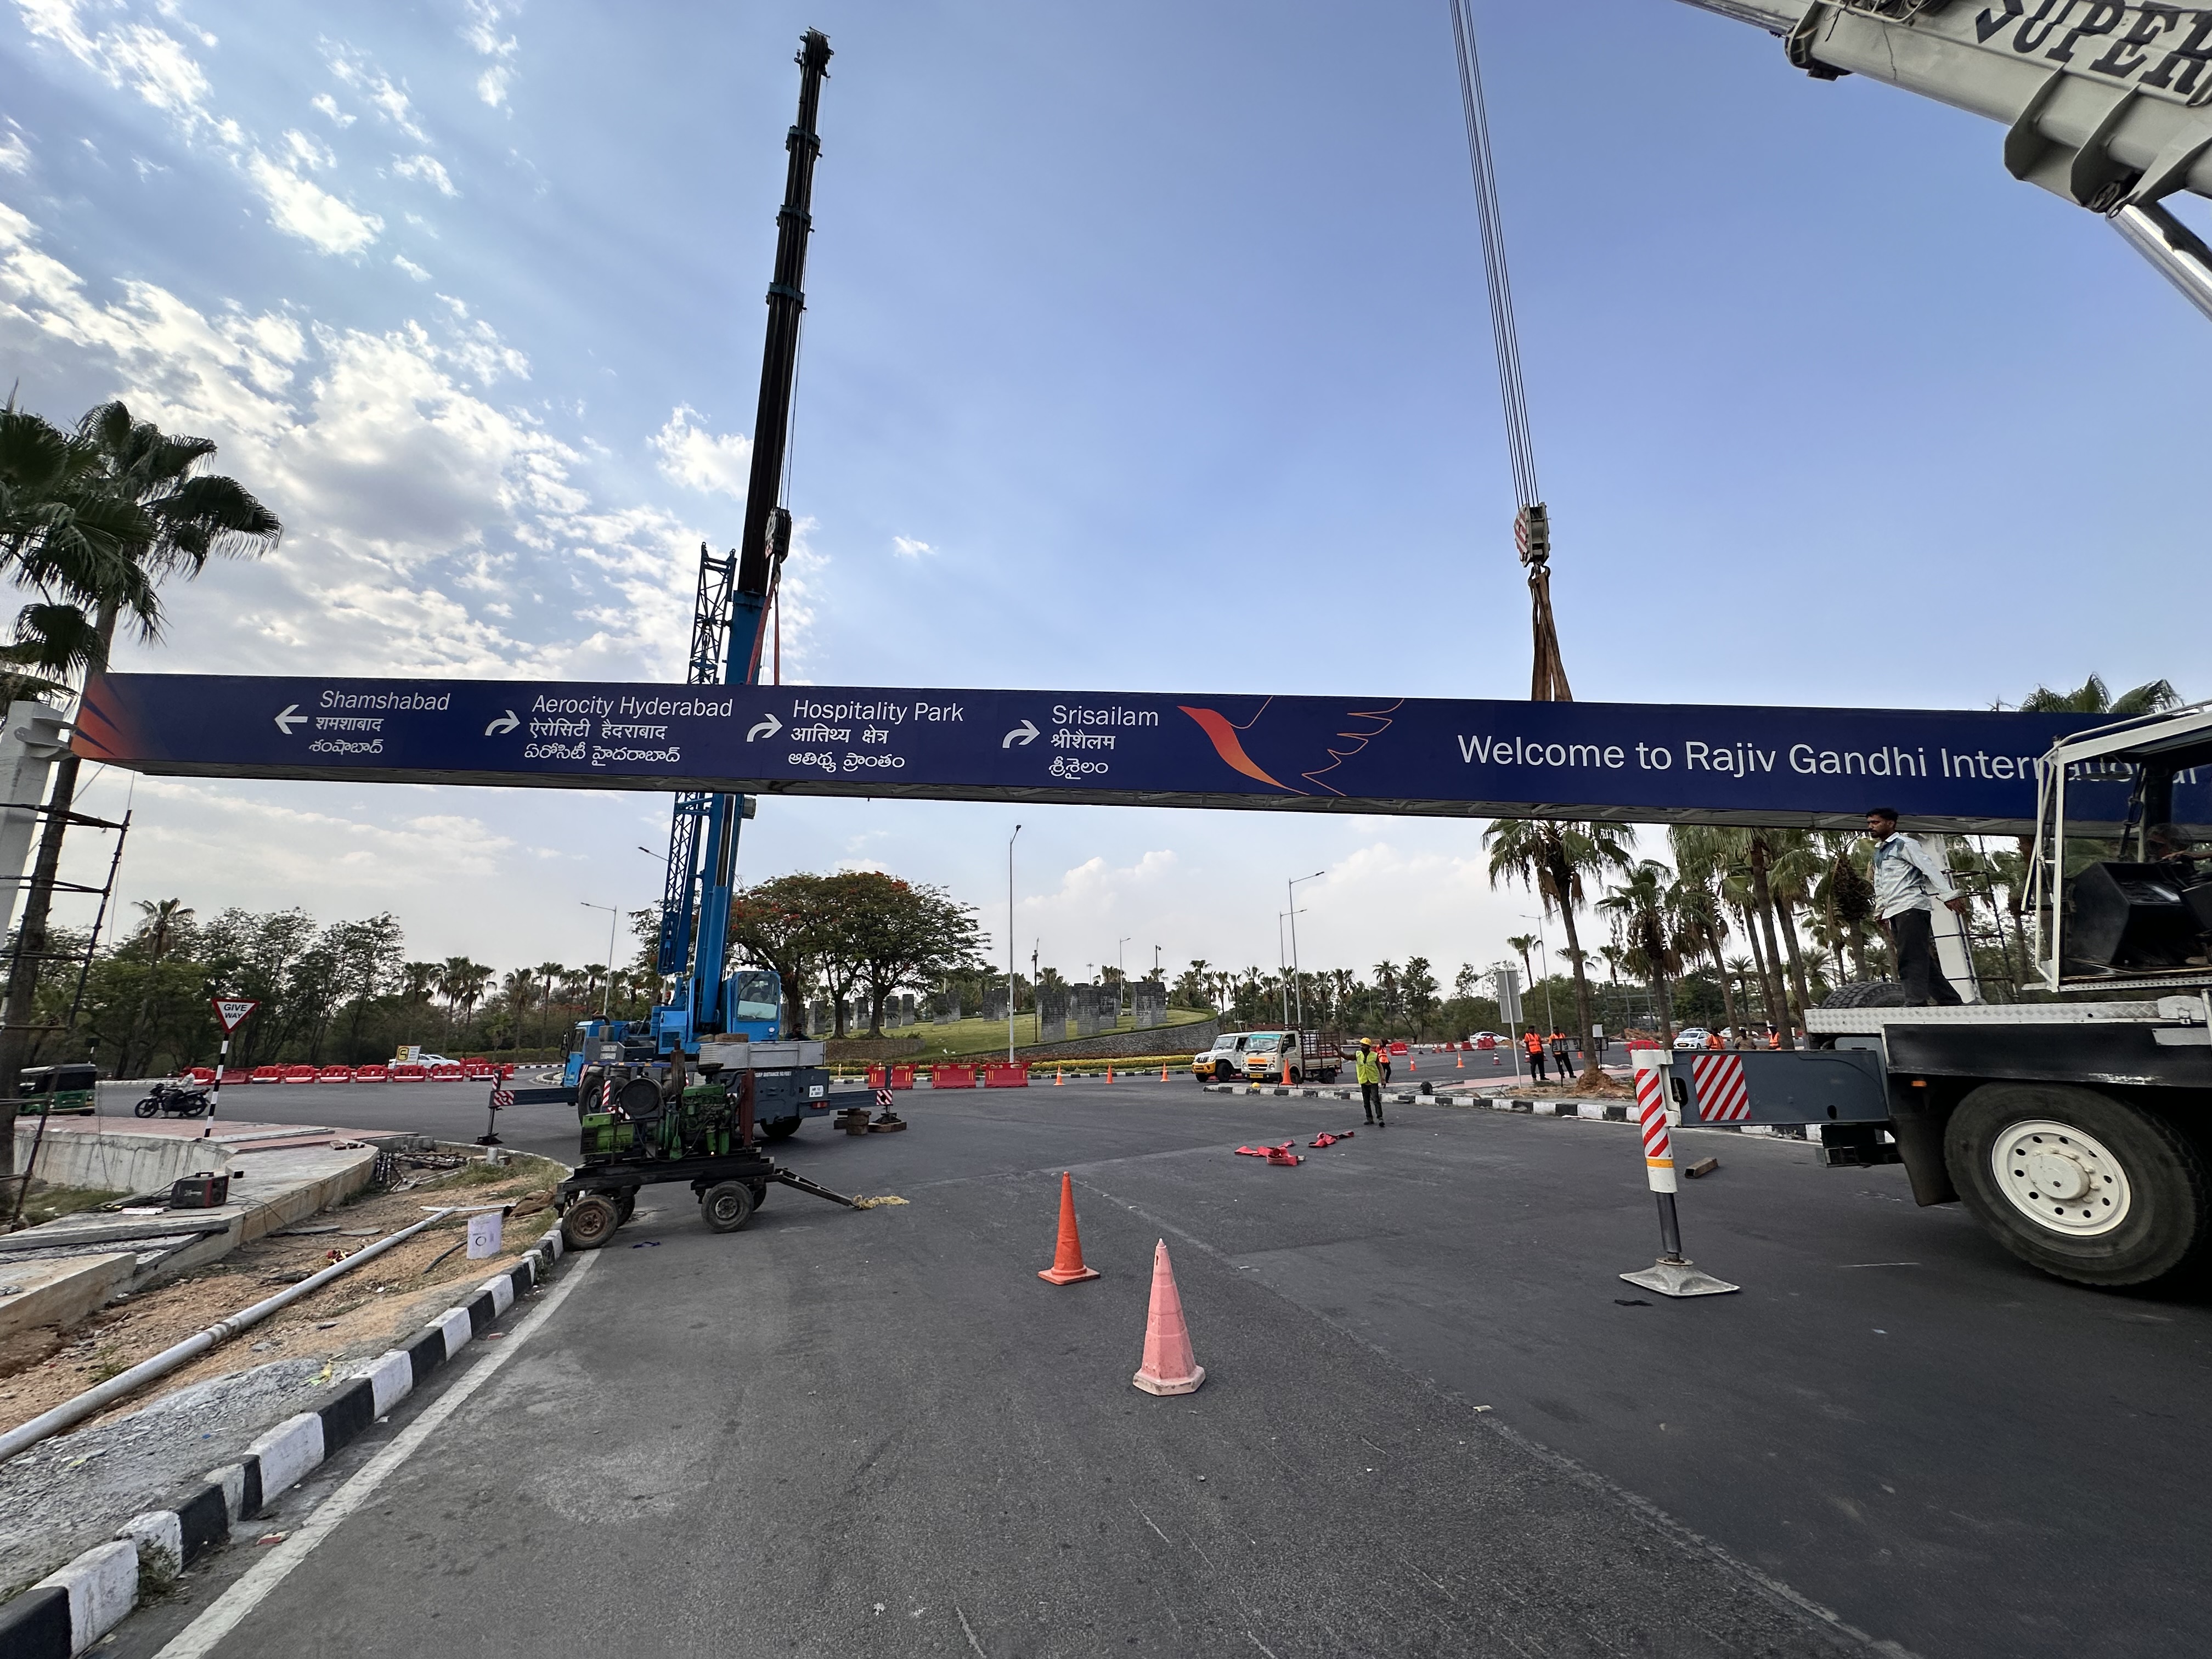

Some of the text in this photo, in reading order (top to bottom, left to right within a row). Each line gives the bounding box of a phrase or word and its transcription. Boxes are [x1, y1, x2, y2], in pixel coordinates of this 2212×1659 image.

[320, 691, 450, 710] Shamshabad
[532, 695, 732, 719] Aerocity Hyderabad
[793, 700, 963, 725] Hospitality Park
[1052, 705, 1158, 726] Srisailam
[316, 717, 384, 731] शमशाबाद
[529, 718, 668, 740] ऐरोसिटी हैदराबाद
[791, 721, 889, 743] आतिथ्य क्षेत्र
[309, 739, 383, 755] శంషాబాద్
[1051, 729, 1115, 749] श्रीशैलम
[524, 742, 680, 766] ఏరోసిటీ హైదరాబాద్
[843, 753, 905, 771] ప్రాంతం
[1458, 735, 1624, 768] Welcome
[1635, 742, 1671, 769] to
[1686, 742, 1775, 777] Rajiv
[1790, 744, 1926, 776] Gandhi
[1049, 756, 1108, 780] శ్రీశైలం
